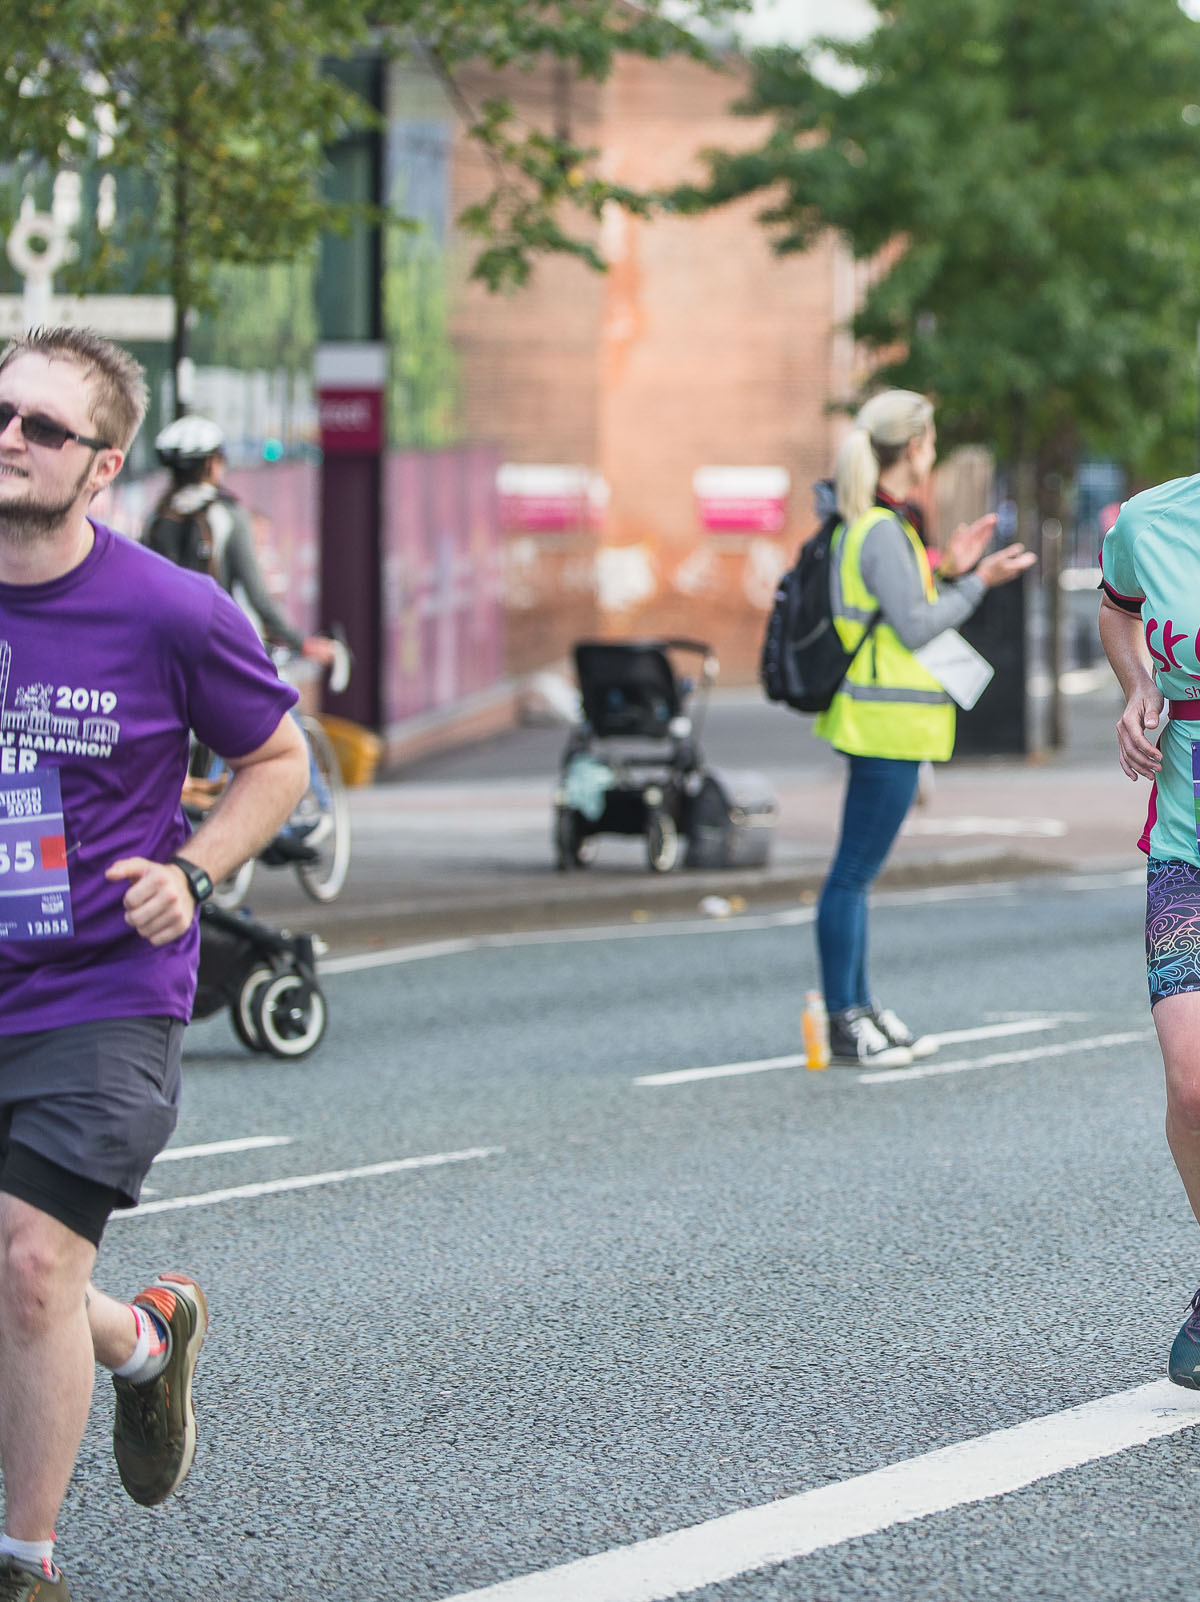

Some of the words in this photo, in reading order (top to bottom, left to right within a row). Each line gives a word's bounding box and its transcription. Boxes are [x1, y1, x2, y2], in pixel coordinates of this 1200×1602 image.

[56, 686, 117, 714] 2019
[19, 732, 112, 758] MARATHON
[1, 747, 38, 774] ER
